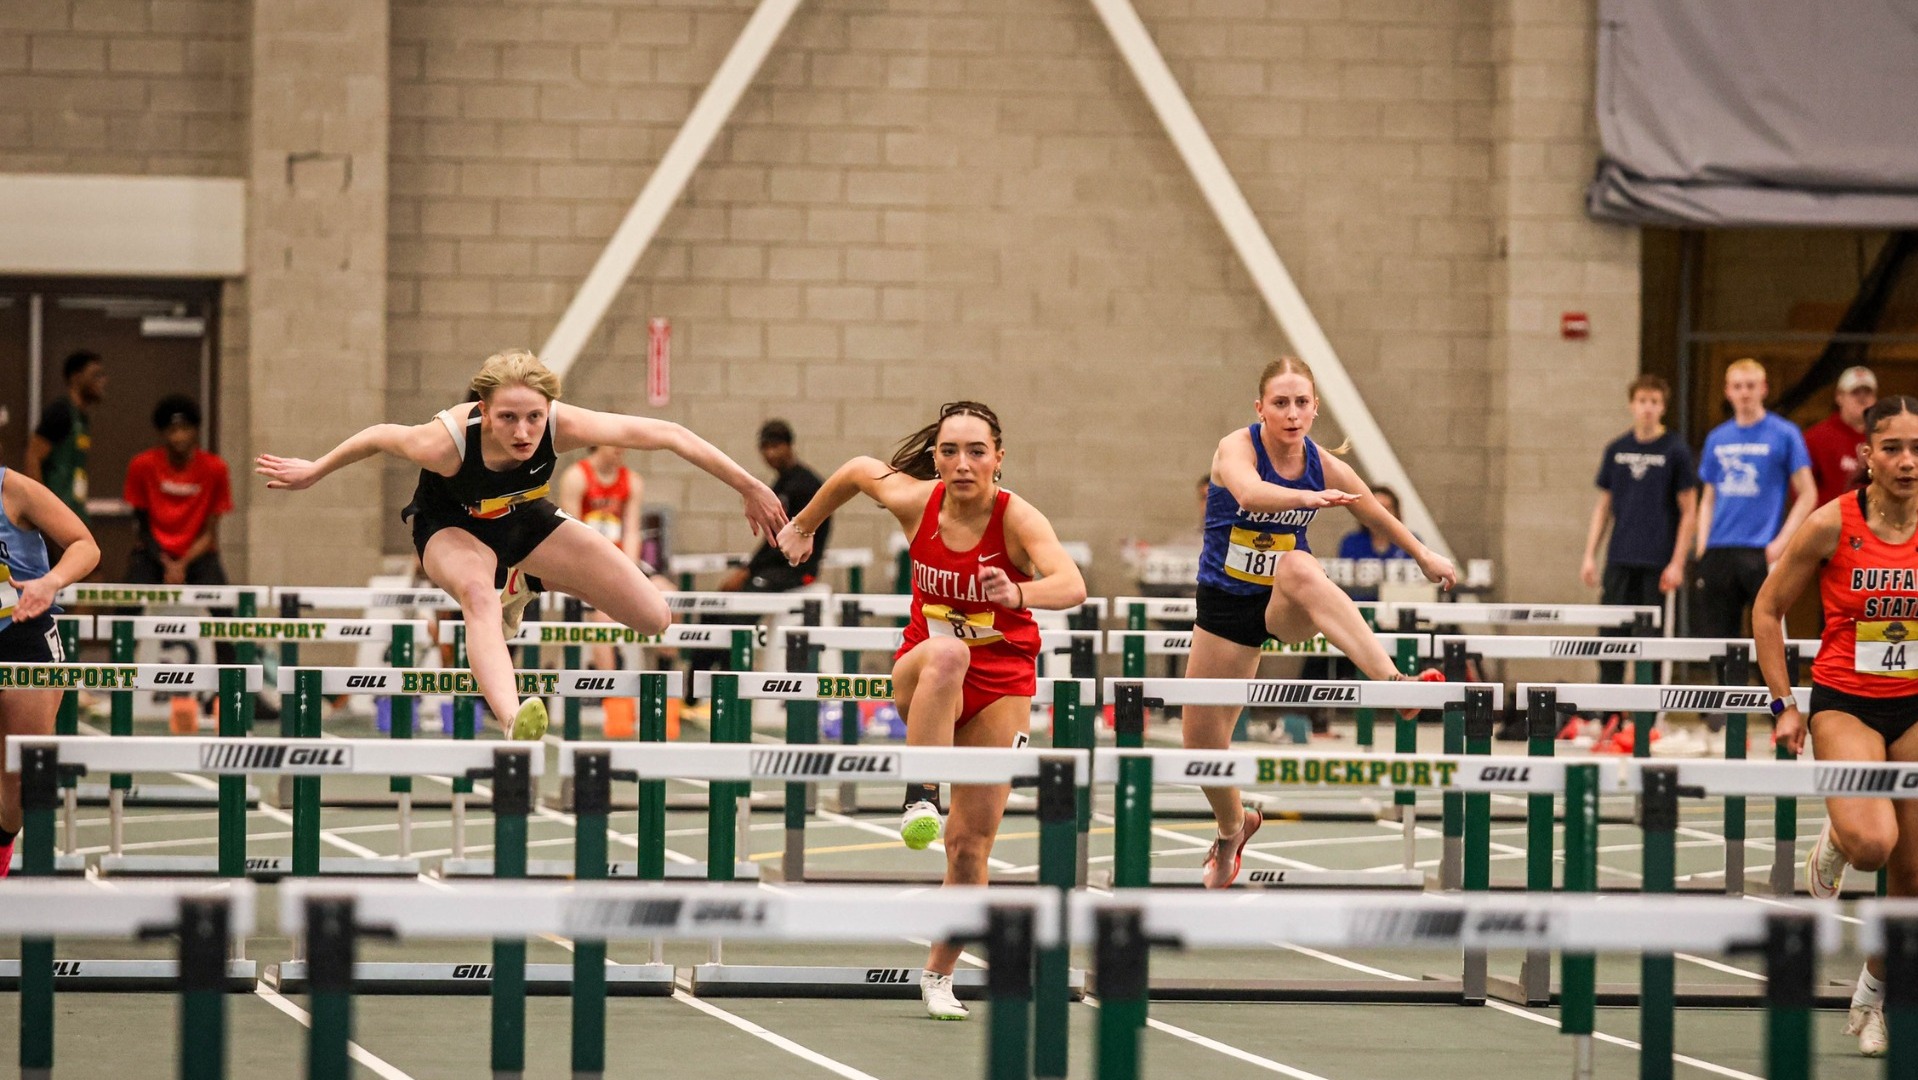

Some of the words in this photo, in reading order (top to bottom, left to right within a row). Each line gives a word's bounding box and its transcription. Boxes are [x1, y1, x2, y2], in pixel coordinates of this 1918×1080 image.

[1245, 551, 1277, 576] 181
[1850, 568, 1918, 592] BUFFA
[77, 588, 183, 602] BROCKPORT
[154, 622, 187, 634] GILL
[199, 620, 327, 639] BROCKPORT
[340, 624, 372, 637] GILL
[679, 630, 712, 642] GILL
[1602, 643, 1638, 655] GILL
[1881, 645, 1906, 671] 44
[153, 671, 195, 685] GILL
[346, 674, 388, 688] GILL
[401, 670, 560, 694] BROCRT
[574, 677, 616, 690] GILL
[762, 679, 803, 693] GILL
[1312, 687, 1356, 701] GILL
[1725, 693, 1769, 707] GILL
[288, 748, 346, 766] GILL
[837, 755, 894, 773] GILL
[1184, 761, 1236, 777] GILL
[1256, 757, 1458, 787] BROCKPORT
[1479, 766, 1532, 783] GILL
[244, 858, 281, 870] GILL
[1249, 870, 1287, 882] GILL
[865, 969, 910, 983] GILL
